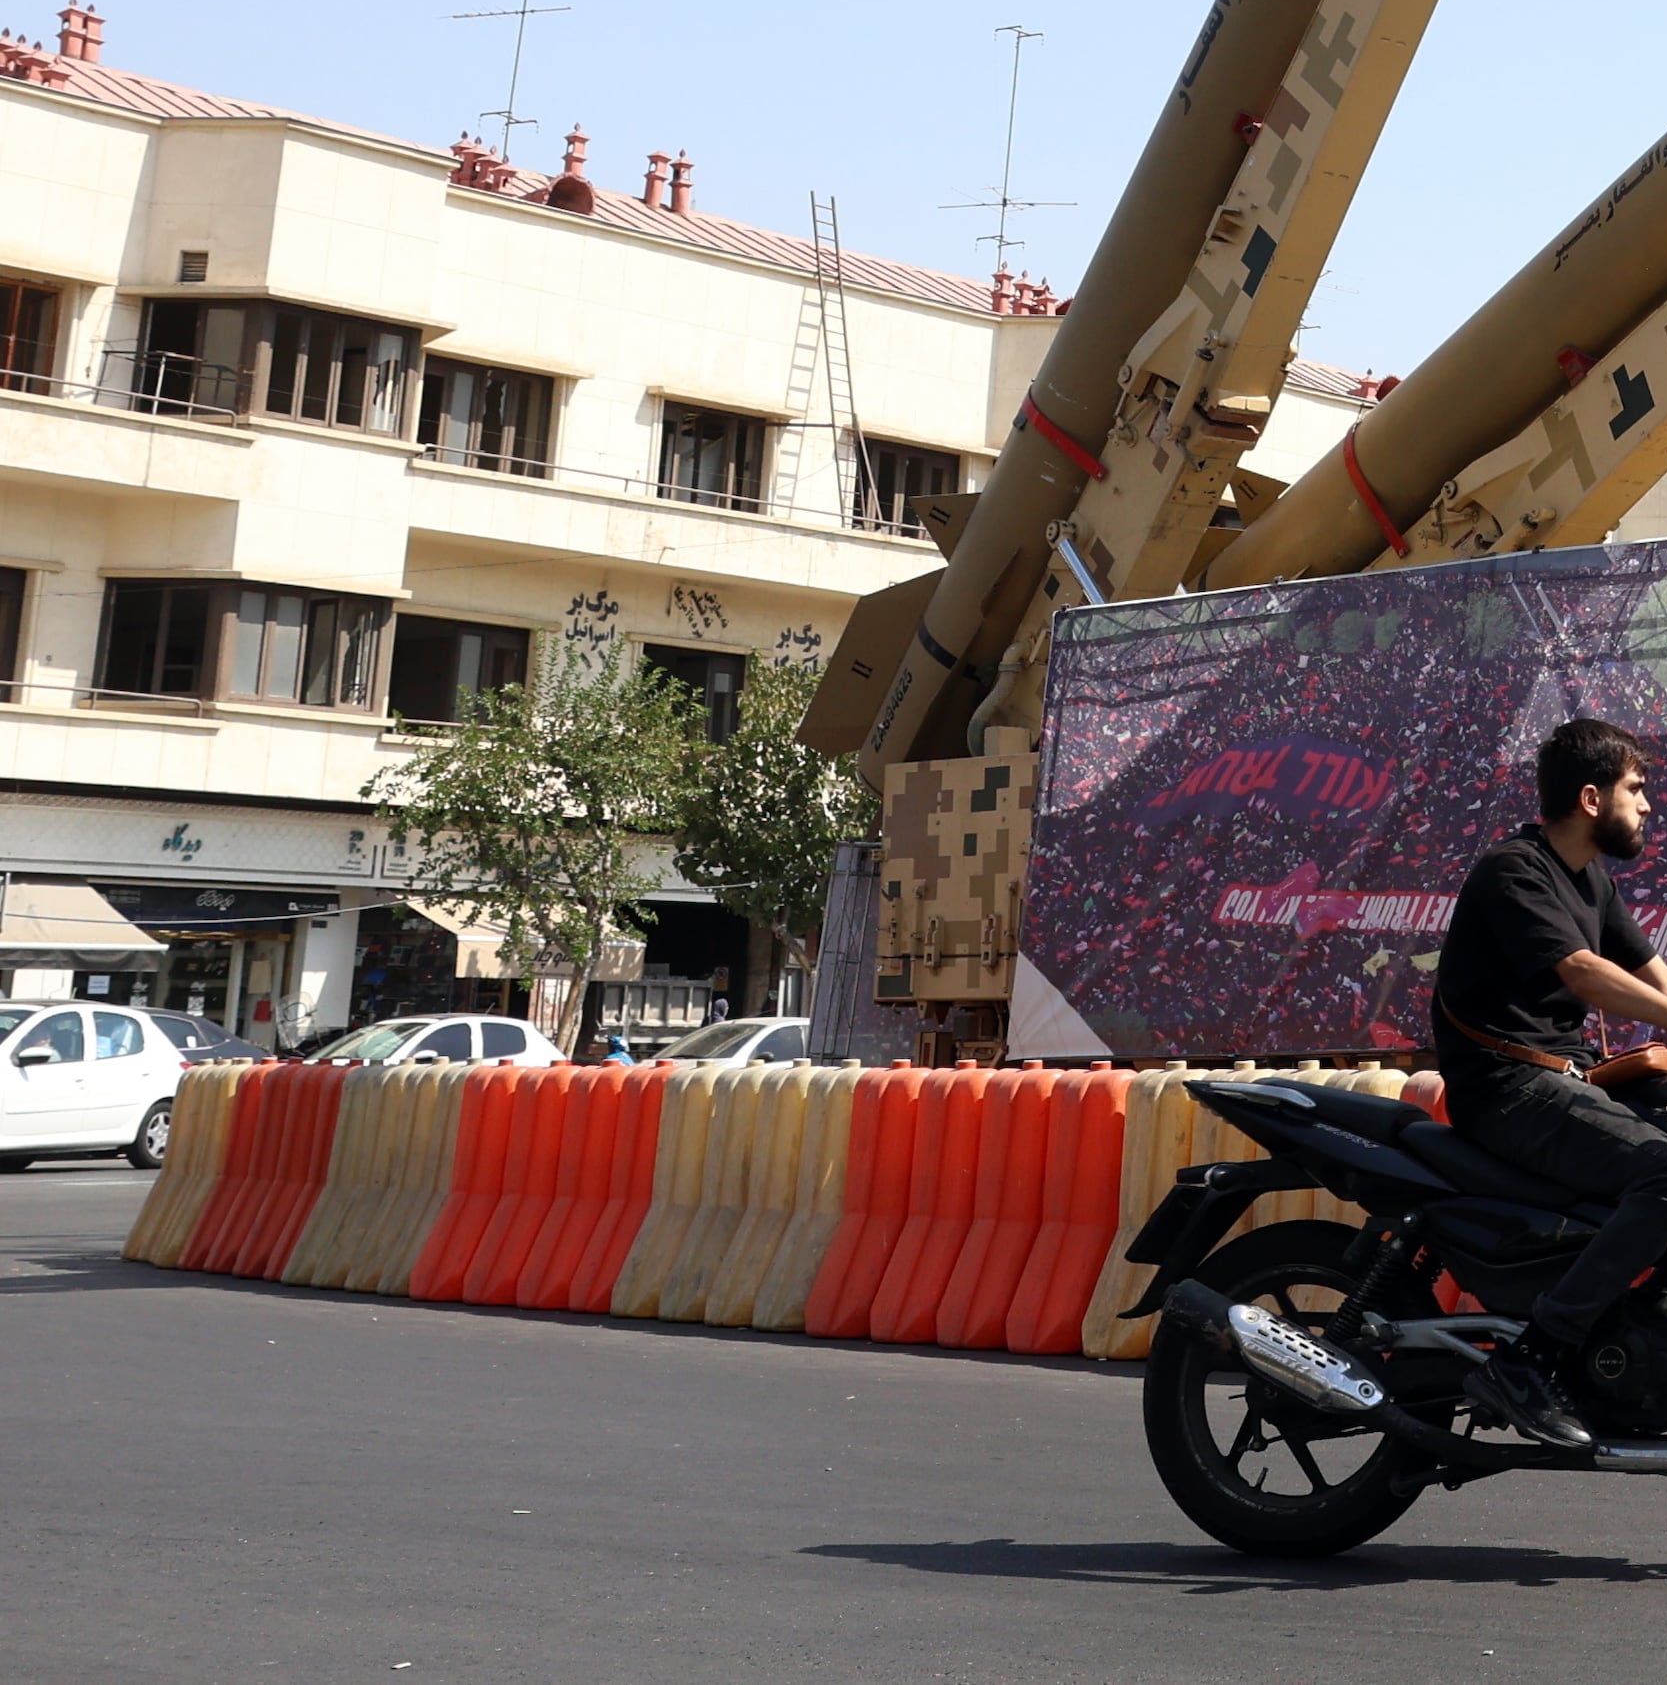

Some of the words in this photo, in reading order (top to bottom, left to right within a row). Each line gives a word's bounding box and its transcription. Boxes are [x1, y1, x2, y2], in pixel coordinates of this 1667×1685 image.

[585, 590, 619, 622] مرگ
[565, 617, 616, 652] اسرائیل
[793, 624, 822, 653] مرگ
[851, 658, 873, 680] II
[1293, 749, 1397, 811] KILL
